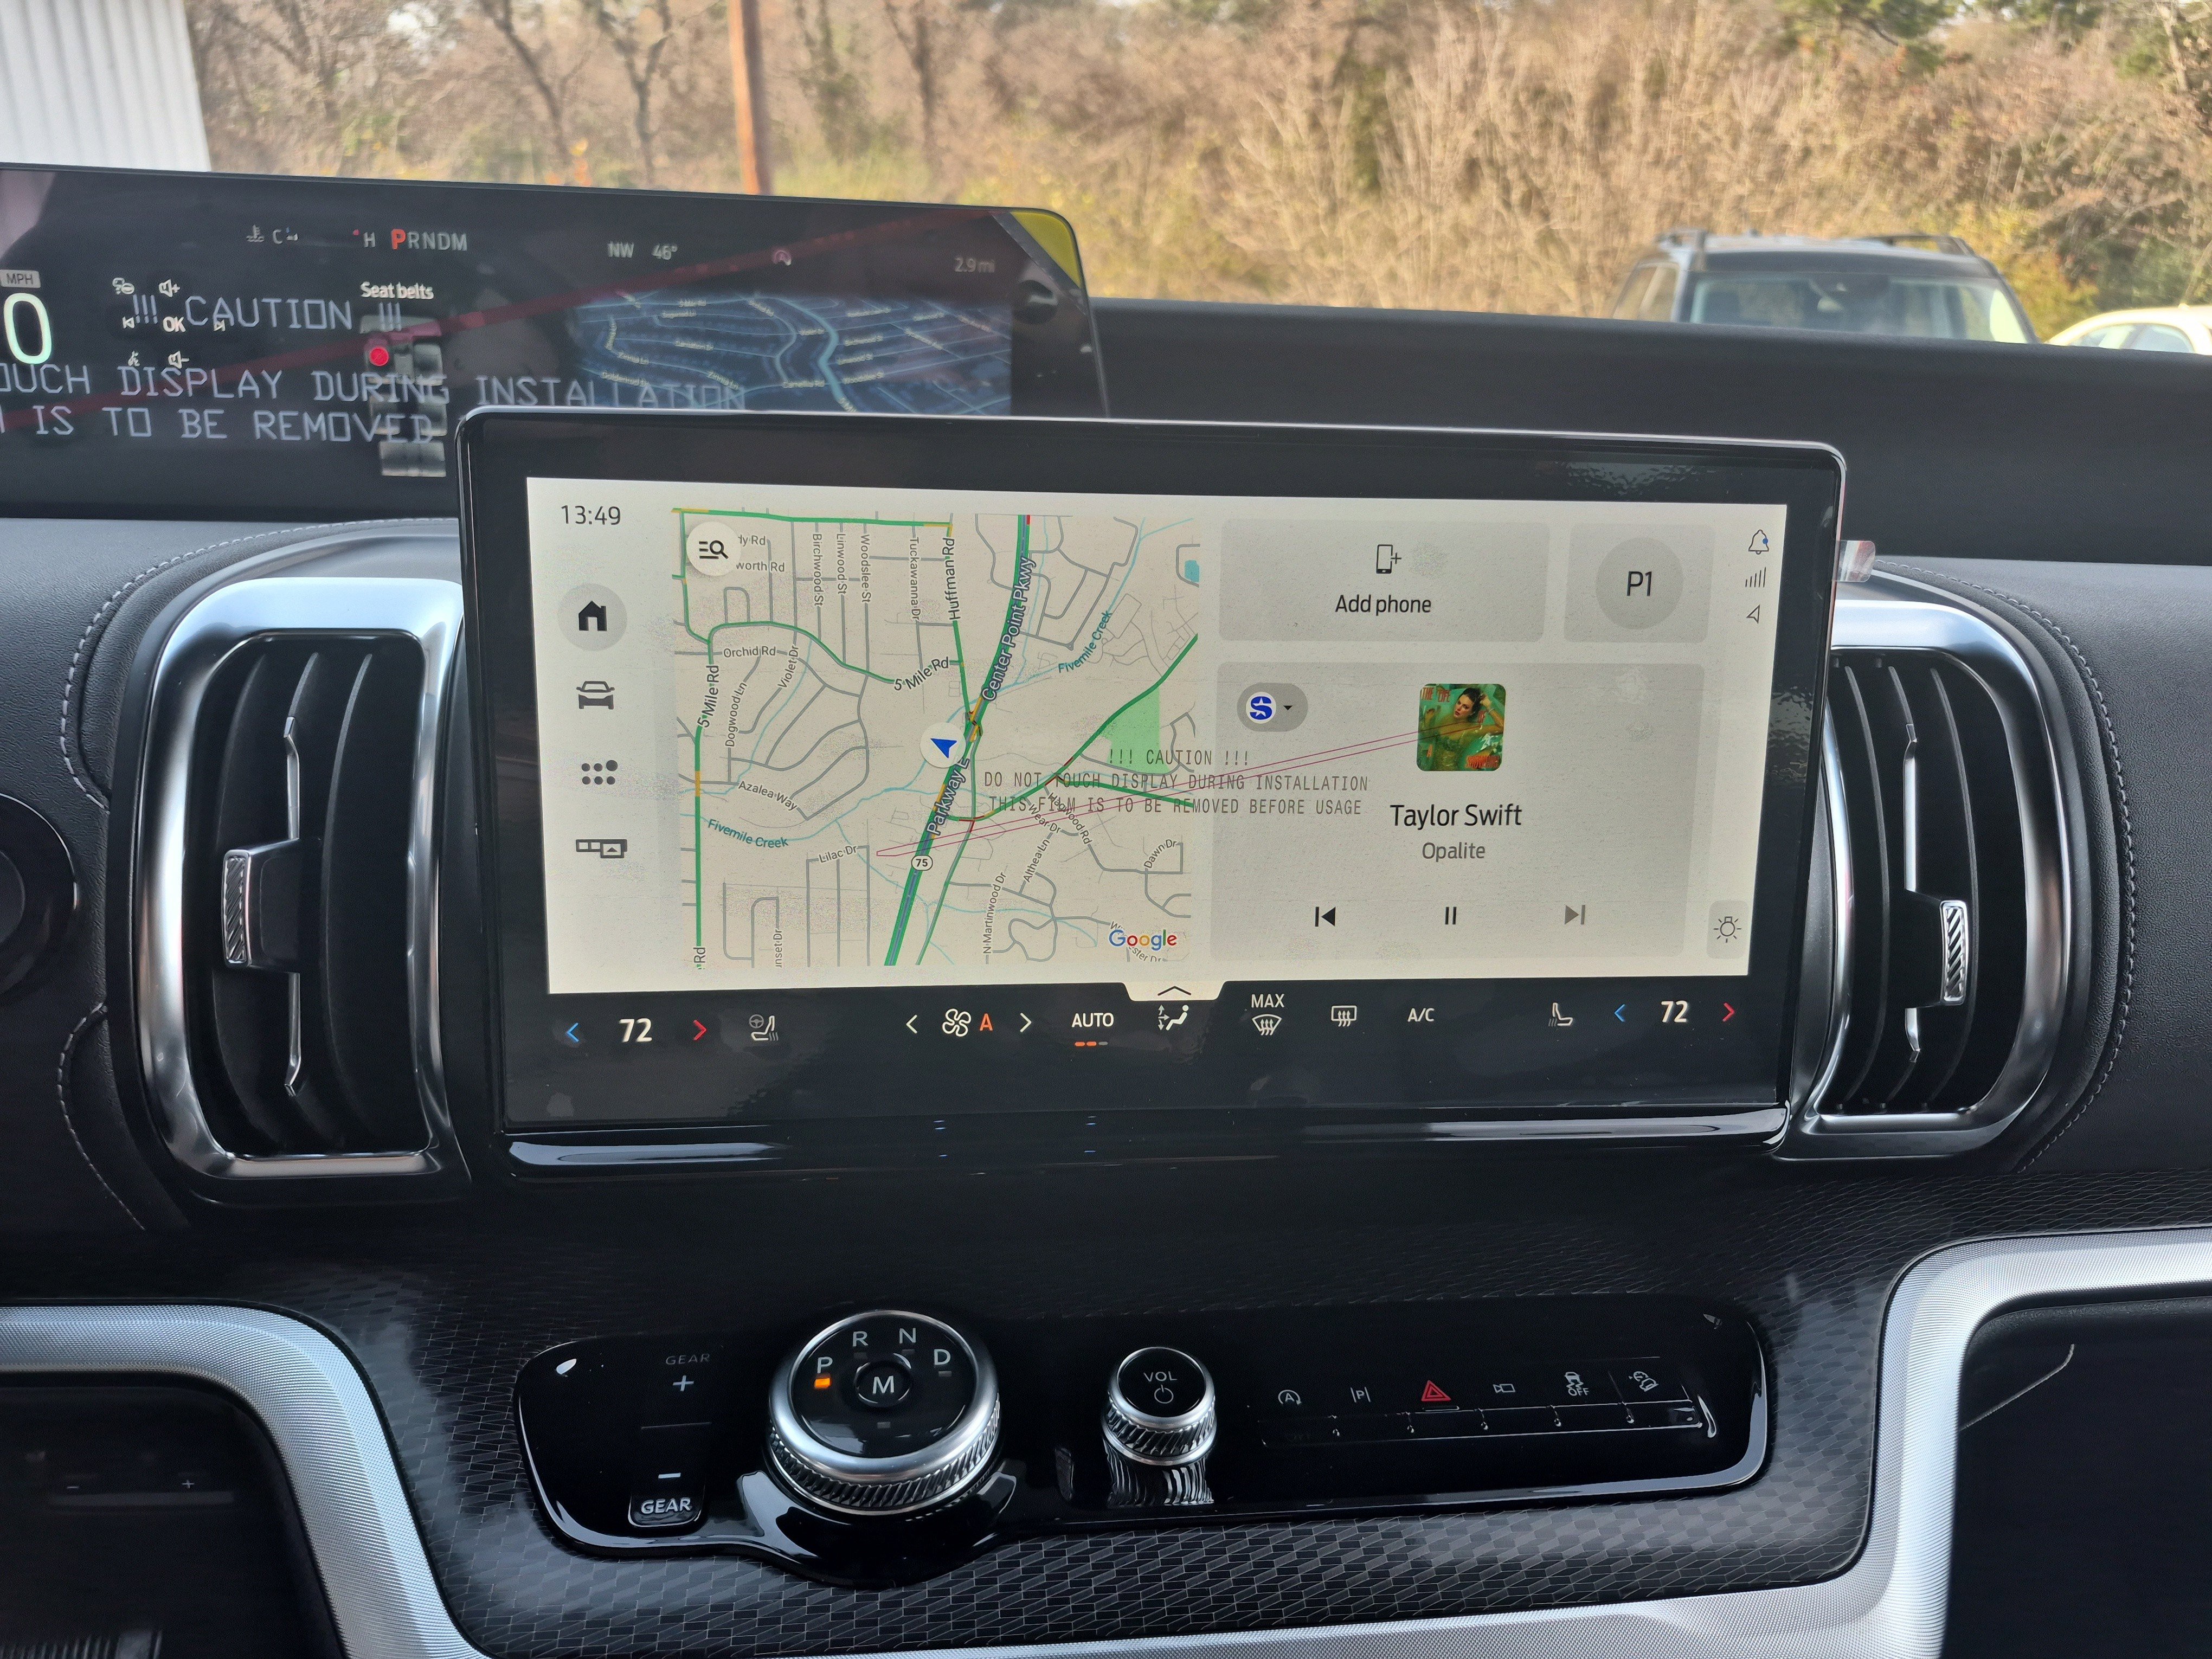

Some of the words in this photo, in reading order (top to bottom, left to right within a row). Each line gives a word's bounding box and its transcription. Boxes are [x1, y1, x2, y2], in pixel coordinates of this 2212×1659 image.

[607, 241, 634, 258] NW
[955, 257, 975, 273] 2.9
[978, 260, 994, 273] mi
[7, 273, 33, 285] MPH
[360, 281, 395, 298] Seat
[397, 281, 434, 300] belts
[185, 295, 352, 330] CAUTION
[3, 293, 52, 364] 0
[163, 316, 186, 332] OK
[117, 365, 282, 399] DISPLAY
[311, 370, 450, 404] DURING
[33, 406, 74, 435] IS
[102, 407, 151, 437] TO
[178, 409, 227, 439] BE
[254, 409, 433, 444] REMOVED
[561, 505, 621, 525] 13:49
[751, 535, 766, 545] Rd
[942, 537, 955, 555] Rd
[813, 533, 823, 593] Birchwood
[837, 533, 846, 579] Linwood
[861, 534, 870, 589] Woodslee
[771, 562, 785, 572] Rd
[909, 537, 918, 606] Tuckawanna
[837, 582, 846, 595] St
[1013, 557, 1036, 602] Pkwy
[1626, 571, 1653, 597] P1
[861, 591, 871, 603] St
[944, 559, 960, 620] Huffman
[815, 595, 823, 606] St
[1335, 595, 1372, 613] Add
[1376, 595, 1431, 616] phone
[911, 608, 920, 620] Dr
[1002, 602, 1025, 647] Point
[1058, 641, 1096, 673] Fivemile
[1092, 610, 1112, 641] Creek
[723, 647, 758, 658] Orchid
[761, 647, 776, 656] Rd
[706, 665, 719, 683] Rd
[777, 659, 797, 689] Violet
[789, 646, 799, 657] Dr
[894, 679, 902, 691] 5
[905, 667, 932, 689] Mile
[931, 657, 949, 670] Rd
[982, 649, 1012, 700] Center
[702, 686, 719, 716] Mile
[698, 718, 710, 728] 5
[725, 695, 743, 747] Dogwood
[736, 682, 747, 695] Ln
[1146, 750, 1212, 766] CAUTION
[985, 772, 1003, 787] DO
[1014, 772, 1042, 787] NOT
[1056, 773, 1100, 788] TOUCH
[1112, 774, 1177, 789] DISPLAY
[1188, 774, 1244, 790] DURING
[1257, 775, 1368, 792] INSTALLATION
[738, 781, 774, 799] Azalea
[774, 792, 798, 811] Way
[927, 769, 966, 835] Parkway
[957, 758, 970, 769] E
[989, 796, 1026, 811] THIS
[1088, 798, 1104, 812] IS
[1117, 798, 1133, 812] TO
[1145, 798, 1162, 813] BE
[1174, 798, 1238, 814] REMOVED
[1250, 799, 1304, 815] BEFORE
[1316, 800, 1361, 815] USAGE
[1027, 803, 1050, 826] Wear
[1050, 822, 1061, 833] Dr
[1390, 805, 1458, 831] Taylor
[1464, 804, 1522, 827] Swift
[708, 820, 753, 844] Fivemile
[755, 837, 788, 848] Creek
[1080, 830, 1092, 844] Rd
[819, 850, 844, 863] Lilac
[845, 846, 857, 855] Dr
[1024, 854, 1042, 882] Althea
[1037, 839, 1050, 851] Ln
[1144, 843, 1165, 869] Dawn
[1165, 839, 1177, 848] Dr
[1422, 841, 1486, 863] Opalite
[916, 859, 928, 867] 75
[983, 885, 1003, 944] Martinwood
[995, 871, 1007, 885] Dr
[774, 929, 782, 940] Dr
[1109, 929, 1177, 951] Google
[693, 947, 705, 963] Rd
[1251, 994, 1285, 1008] MAX
[1071, 1013, 1114, 1028] AUTO
[1407, 1007, 1436, 1023] A/C
[1661, 1001, 1689, 1023] 72
[619, 1019, 653, 1043] 72
[979, 1013, 994, 1031] A
[852, 1330, 868, 1348] R
[899, 1328, 917, 1344] N
[666, 1353, 710, 1365] GEAR
[818, 1356, 833, 1373] P
[934, 1349, 951, 1366] D
[873, 1375, 896, 1395] M
[1144, 1371, 1177, 1383] VOL
[1568, 1388, 1589, 1396] OFF
[641, 1497, 692, 1514] GEAR
